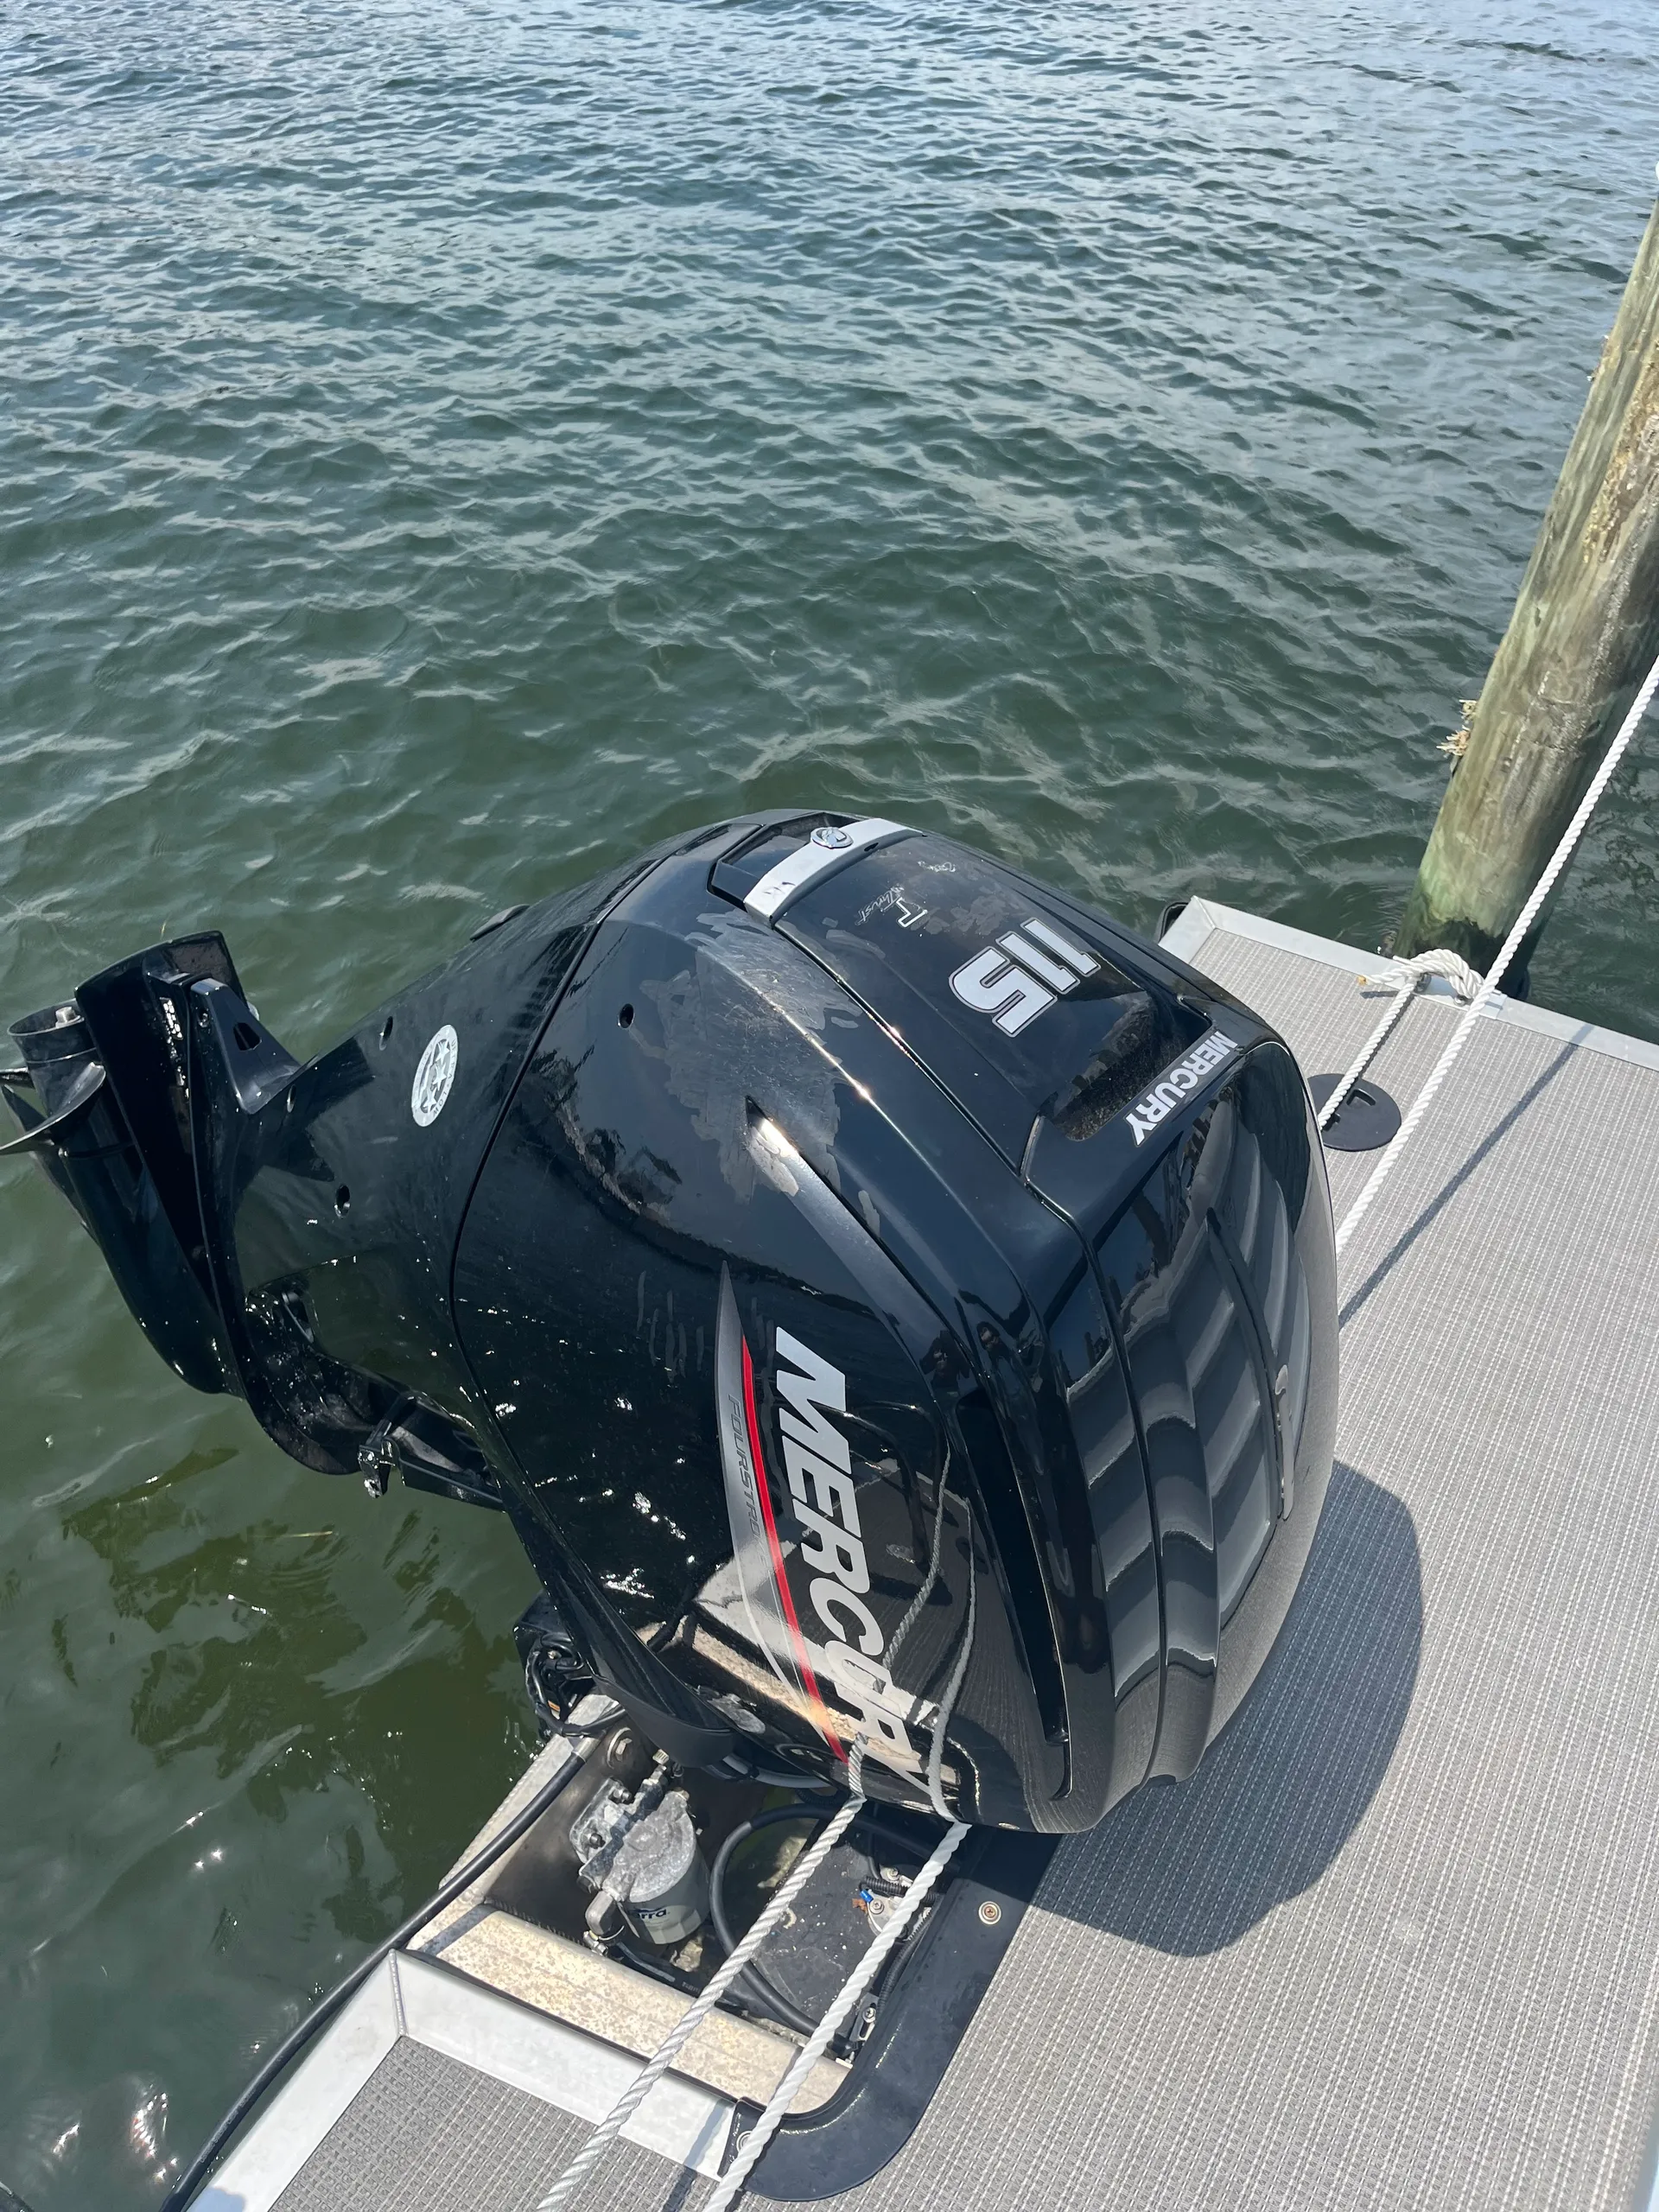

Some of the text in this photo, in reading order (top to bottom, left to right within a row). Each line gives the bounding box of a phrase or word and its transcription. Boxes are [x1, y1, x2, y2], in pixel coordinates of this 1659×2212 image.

[949, 917, 1101, 1037] 115
[1125, 1030, 1238, 1147] MERCURY
[776, 1325, 935, 1796] MERCURY
